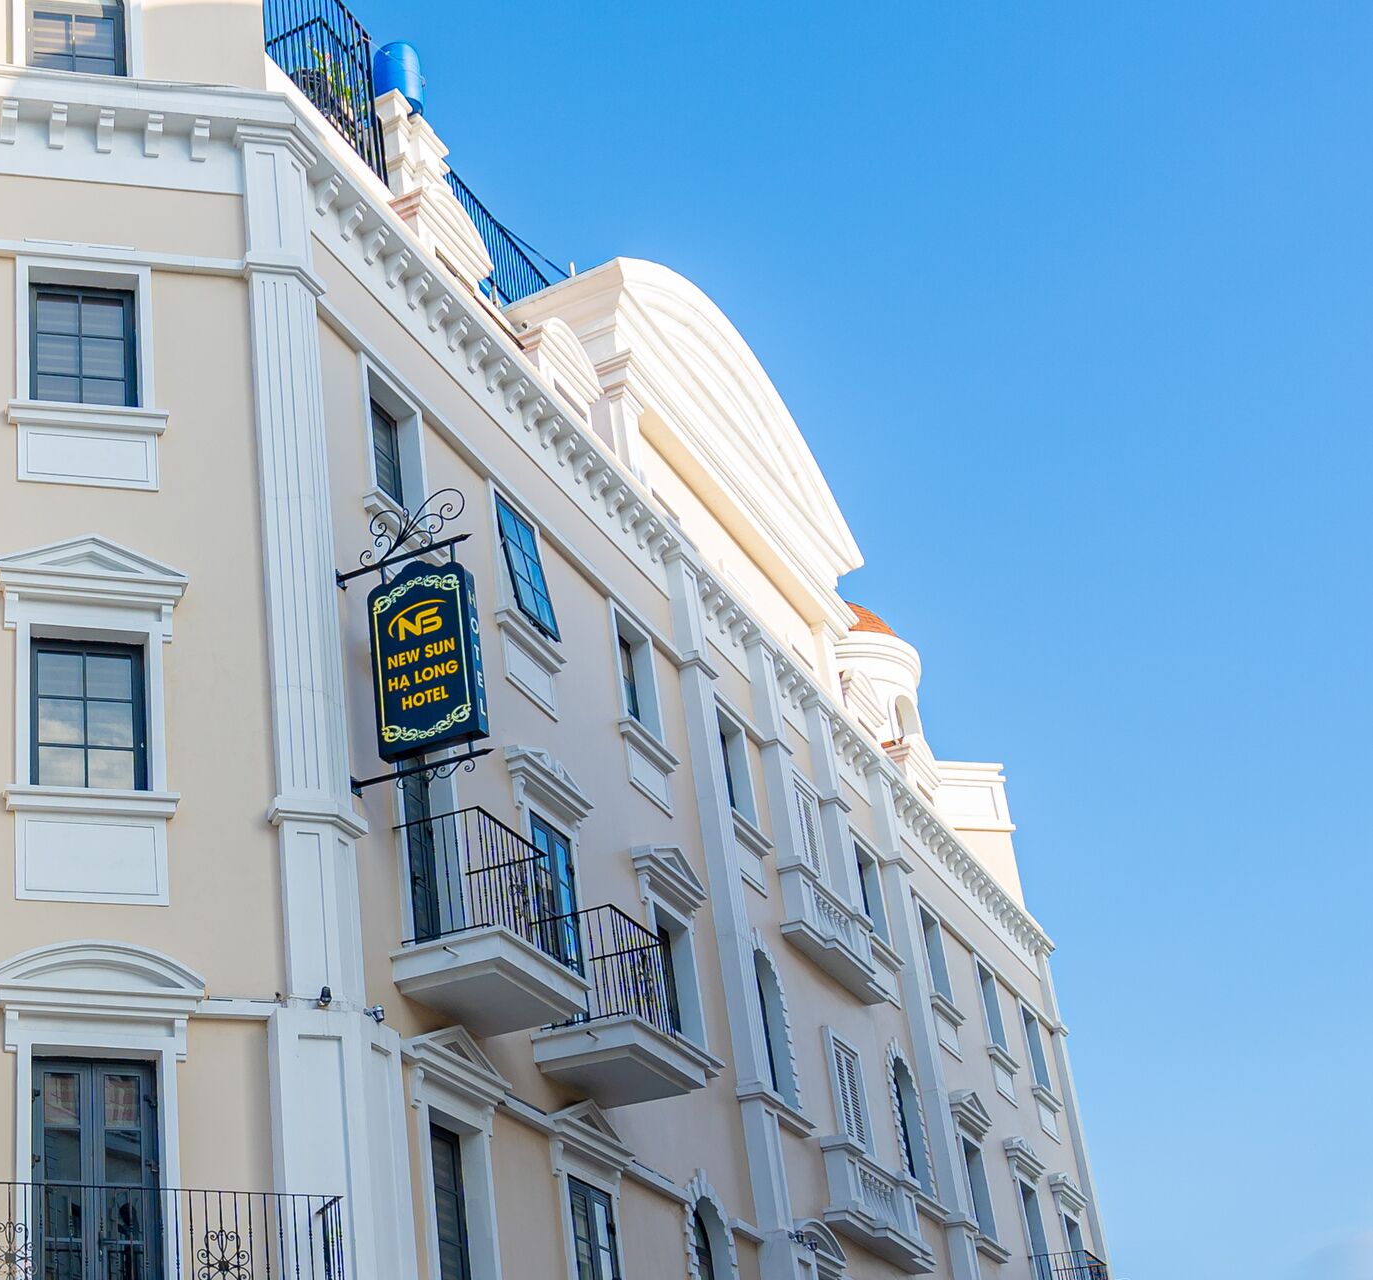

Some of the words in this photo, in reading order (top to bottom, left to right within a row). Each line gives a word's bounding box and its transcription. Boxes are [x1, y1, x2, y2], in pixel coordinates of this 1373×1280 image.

[387, 647, 419, 670] NEW
[424, 637, 455, 659] SUN
[468, 589, 487, 717] HOTEL
[387, 674, 410, 693] HẠ
[414, 659, 459, 685] LONG
[401, 685, 449, 712] HOTEL
